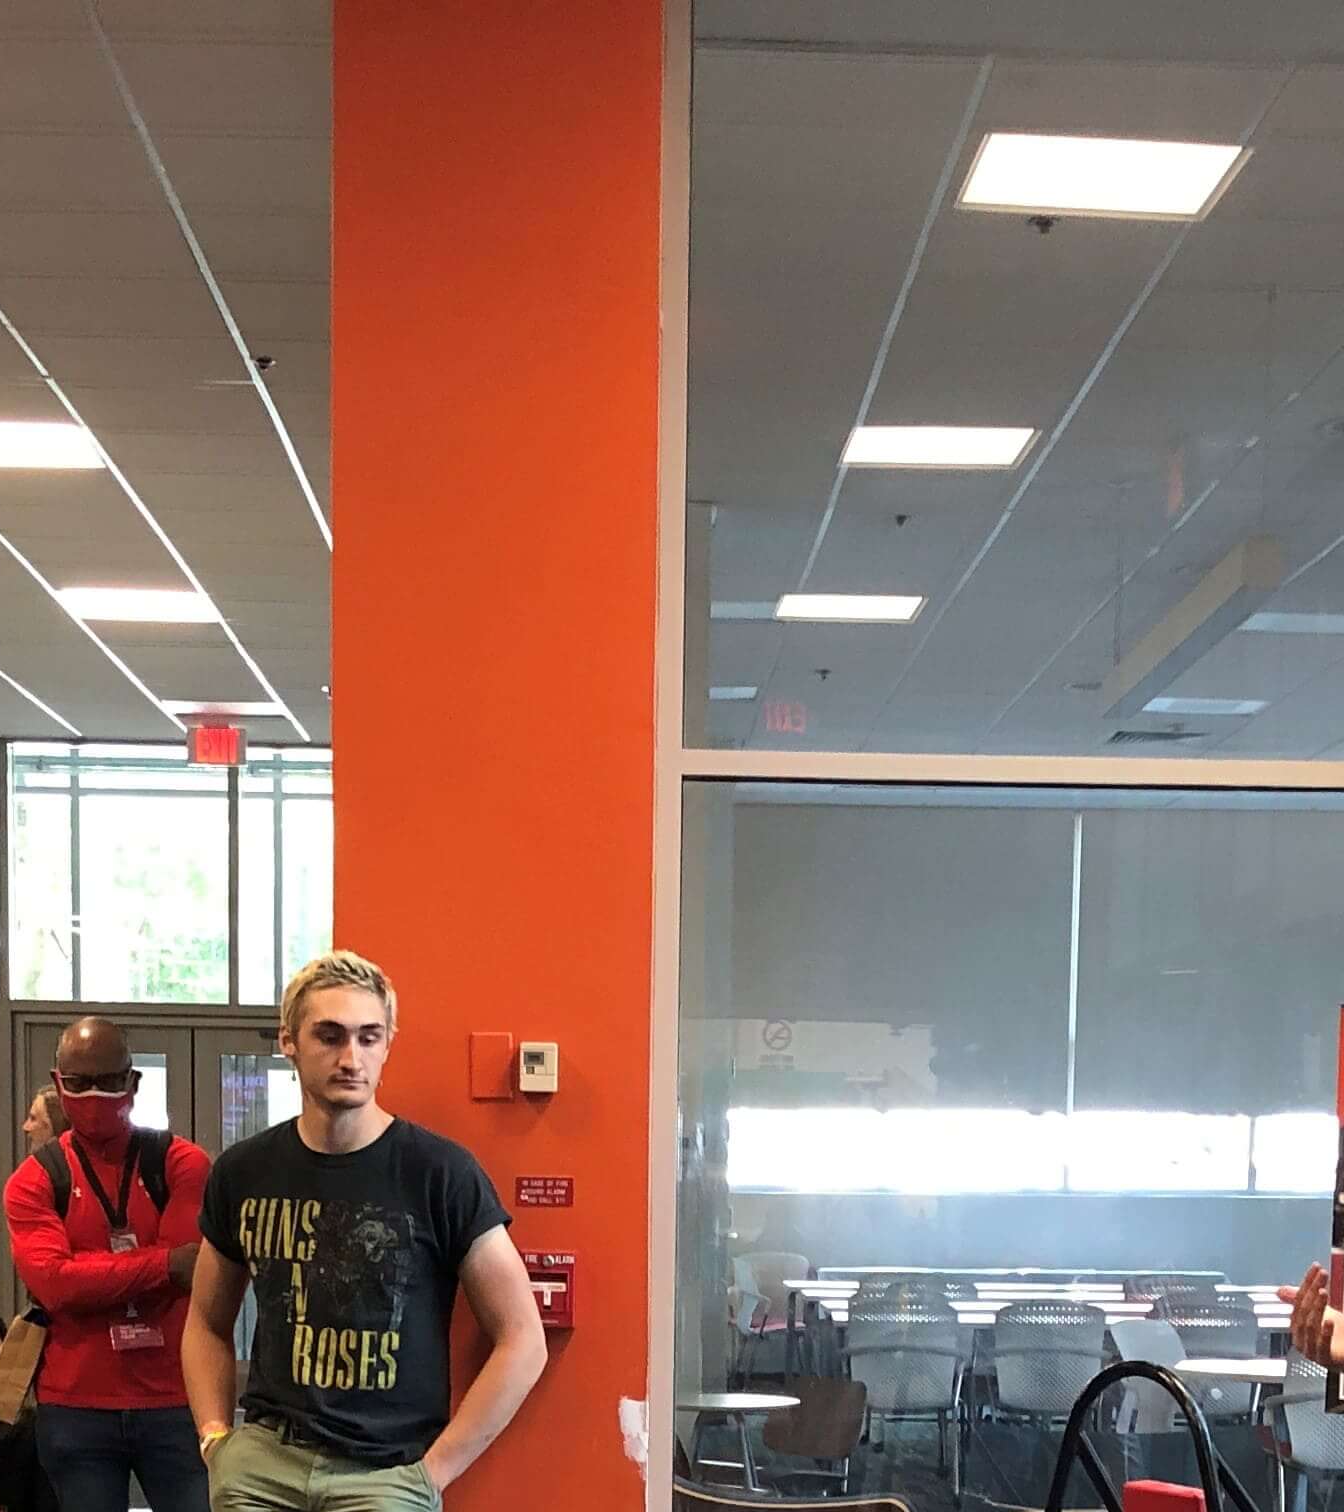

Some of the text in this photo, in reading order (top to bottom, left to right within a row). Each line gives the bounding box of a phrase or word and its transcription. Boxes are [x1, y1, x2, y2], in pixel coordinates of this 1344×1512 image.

[239, 1197, 322, 1262] GUNS
[524, 1254, 575, 1264] FIRE ALARM
[291, 1324, 400, 1391] ROSES
